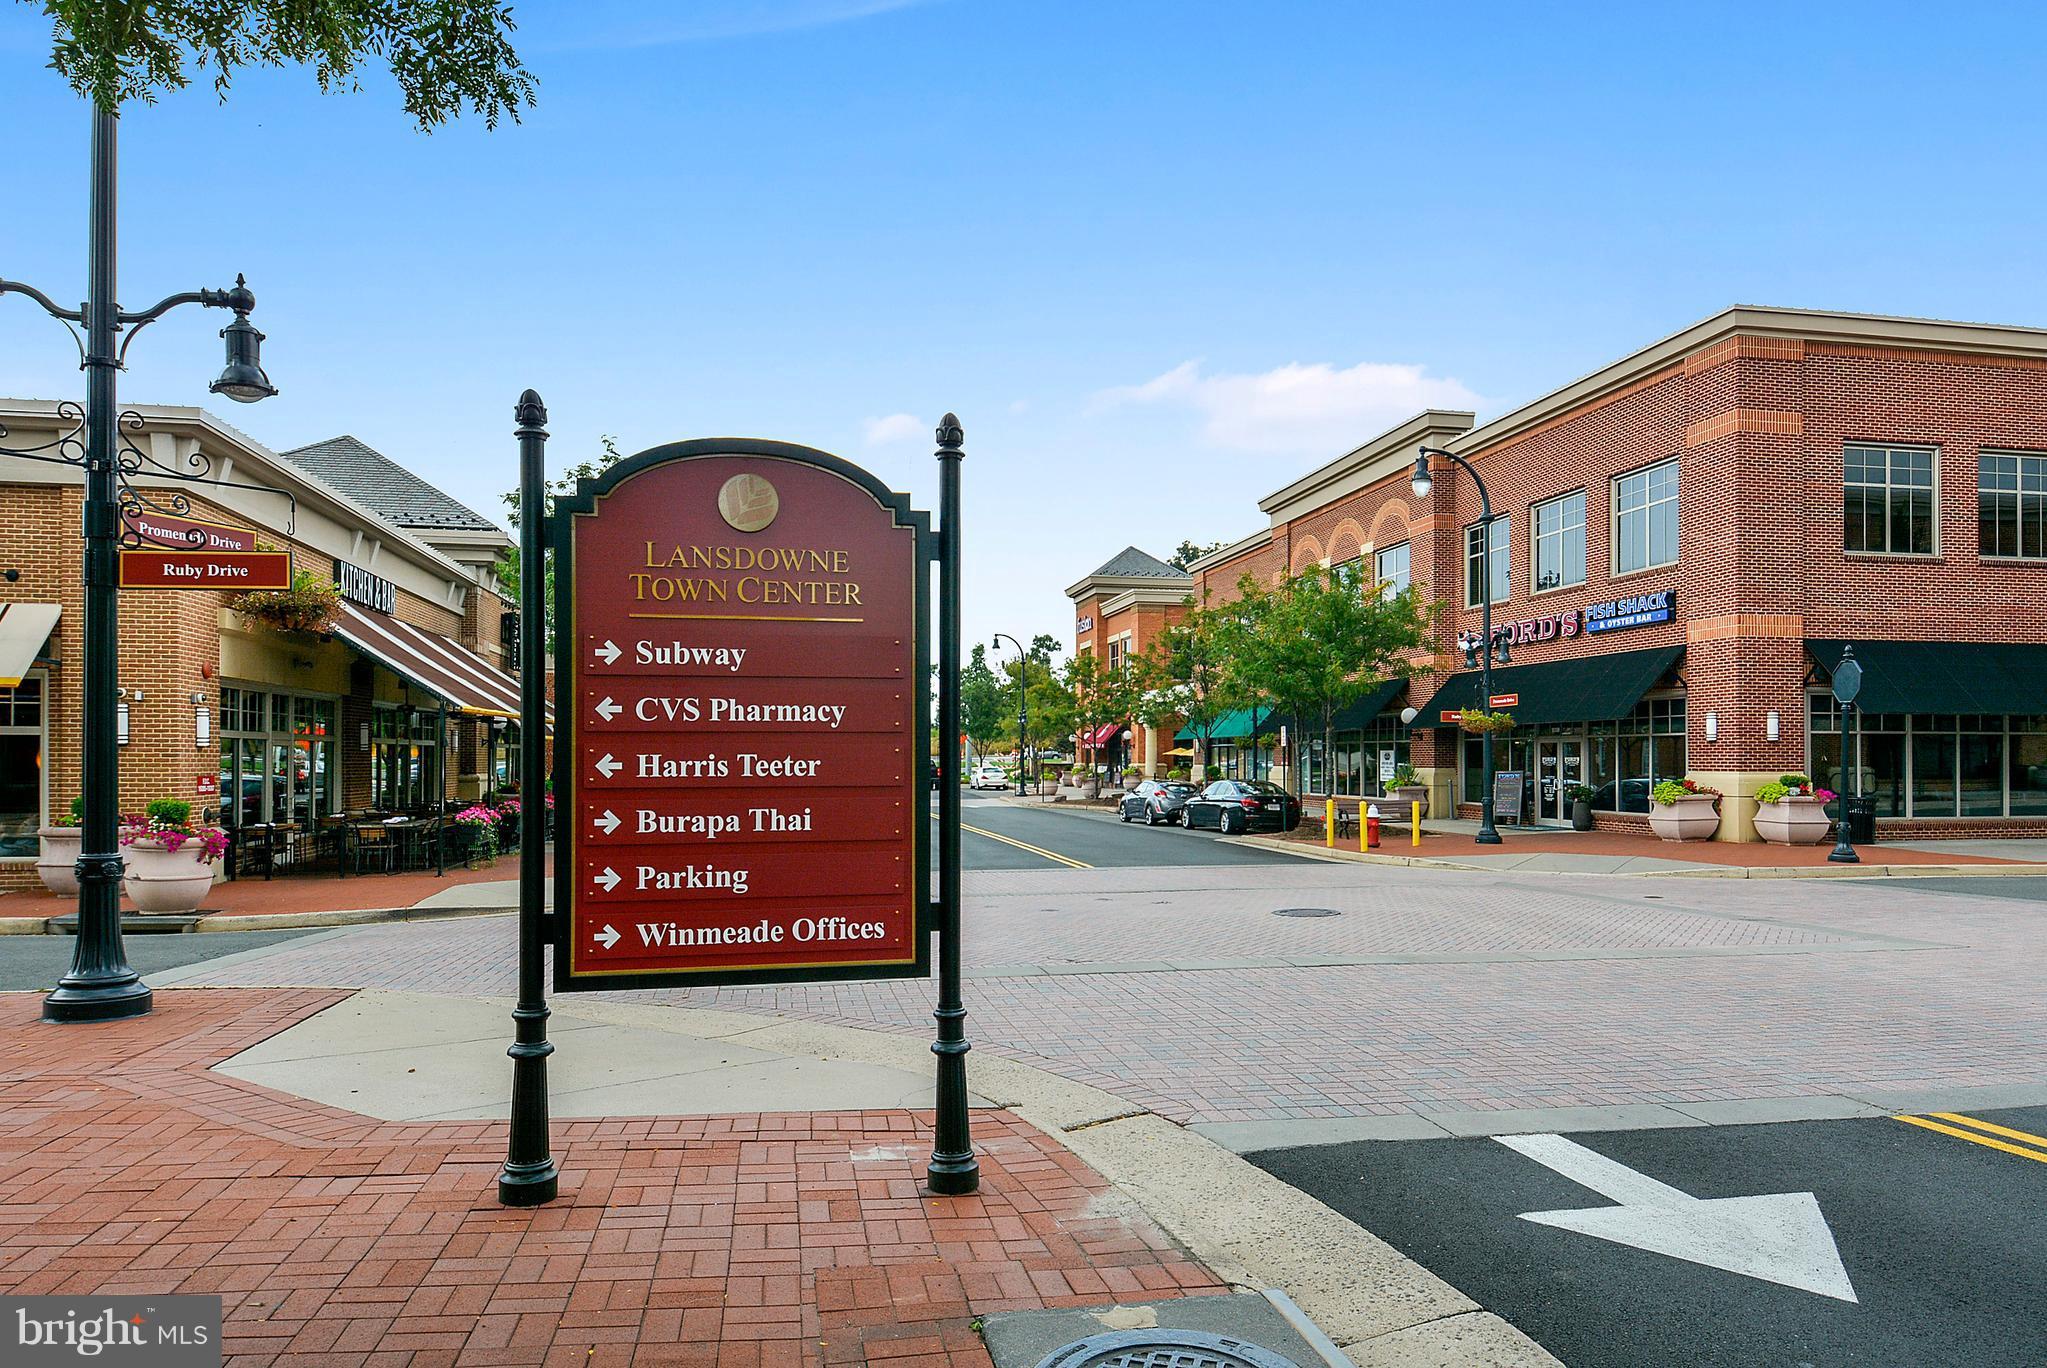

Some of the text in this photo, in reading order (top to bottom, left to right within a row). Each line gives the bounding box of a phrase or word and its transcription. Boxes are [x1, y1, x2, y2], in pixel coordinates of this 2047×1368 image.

[209, 534, 242, 551] Drive
[644, 541, 850, 573] LANSDOWNE
[162, 563, 249, 581] Ruby Drive
[340, 561, 396, 615] KITCHEN & BAR
[628, 573, 863, 606] TOWN CENTER
[1585, 591, 1668, 622] FISH SHACK
[1607, 615, 1635, 628] OYSTER
[1636, 613, 1652, 623] BAR
[635, 640, 747, 672] Subway
[634, 697, 847, 729] CVS Pharmacy
[636, 753, 822, 778] Harris Teeter
[636, 807, 813, 838] Burapa Thai
[635, 864, 749, 894] Parking
[636, 916, 885, 947] Winmeade Offices
